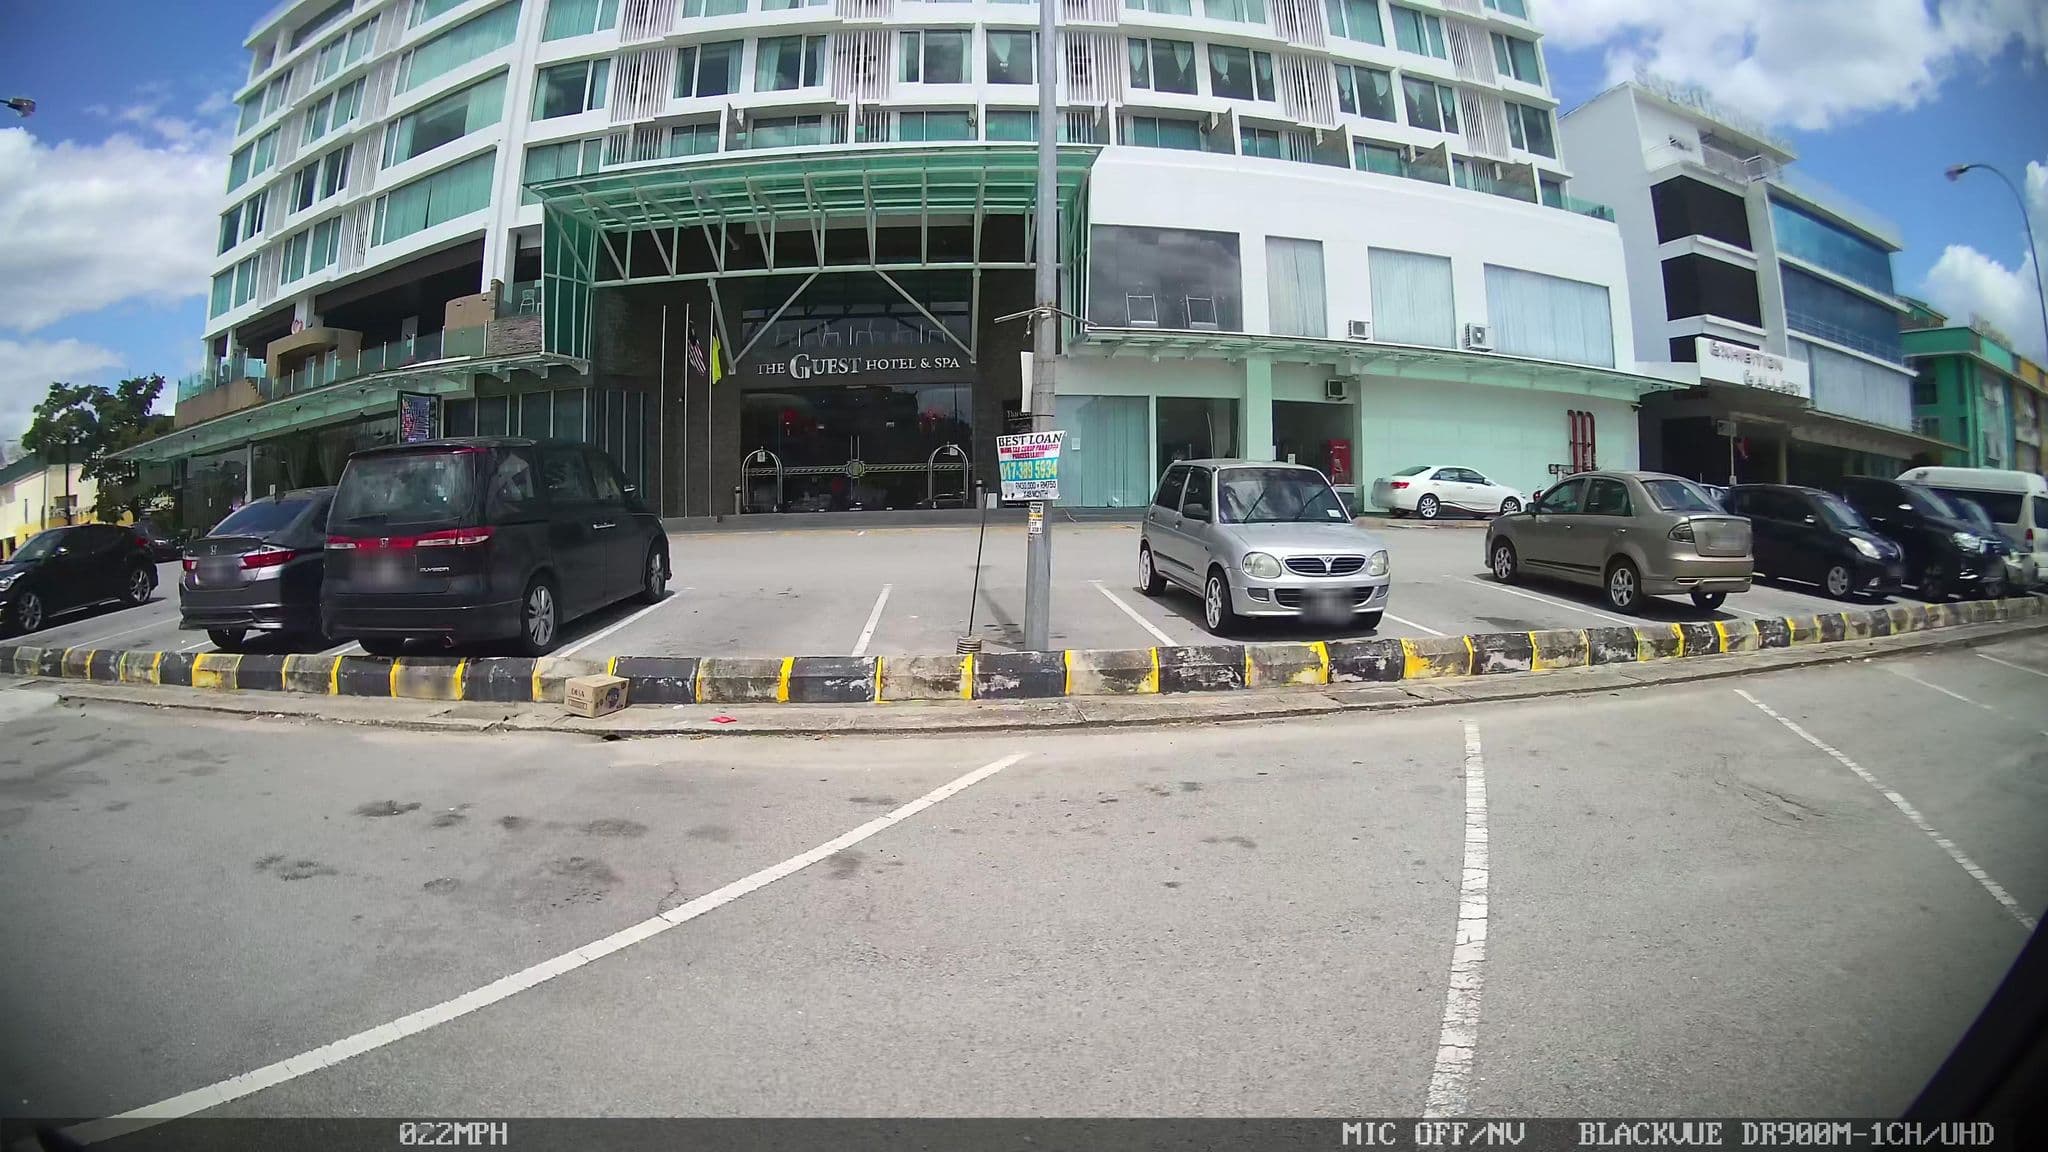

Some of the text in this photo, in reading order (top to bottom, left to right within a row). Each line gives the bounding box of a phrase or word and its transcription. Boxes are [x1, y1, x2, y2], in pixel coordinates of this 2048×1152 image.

[757, 353, 960, 379] THE GUEST HOTEL & SPA
[999, 433, 1063, 447] BEST LOAN
